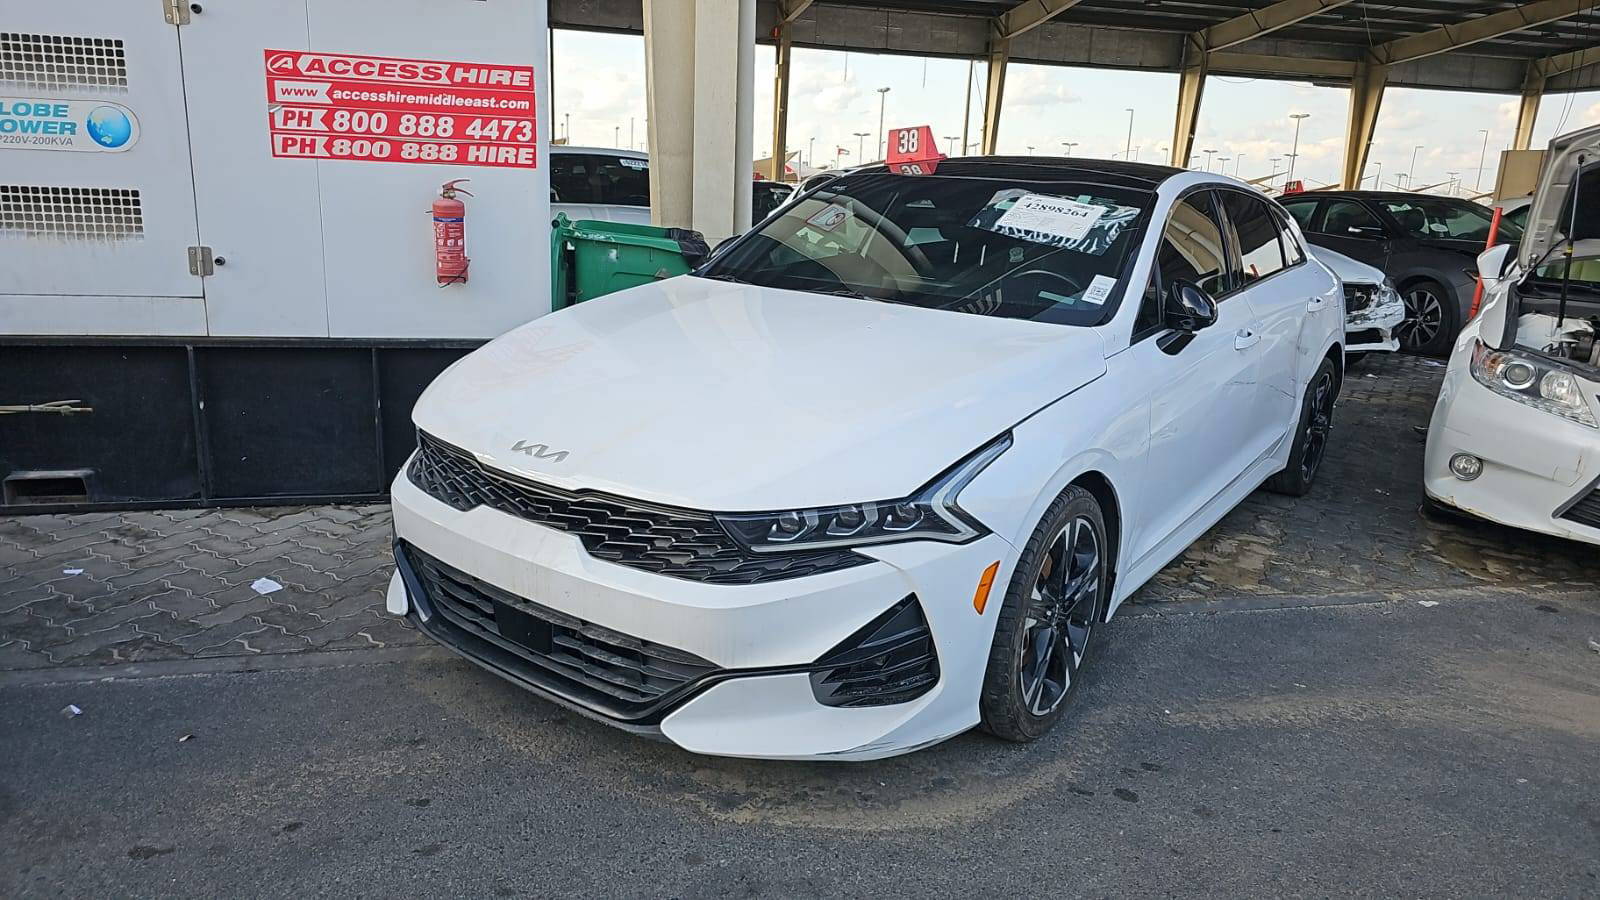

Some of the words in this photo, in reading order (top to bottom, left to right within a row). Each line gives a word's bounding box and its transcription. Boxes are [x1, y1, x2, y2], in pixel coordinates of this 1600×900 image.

[304, 58, 444, 81] ACCESS
[453, 67, 531, 86] HIRE
[280, 87, 318, 97] www
[333, 88, 530, 110] accesshiremiddleeast.com
[282, 109, 313, 127] PH
[332, 110, 388, 133] 800
[398, 114, 454, 138] 888
[465, 119, 532, 142] 4473
[281, 137, 317, 154] PH
[331, 138, 391, 158] 800
[400, 142, 458, 161] 888
[467, 145, 534, 165] HIRE
[898, 129, 918, 153] 38
[1023, 203, 1088, 218] 42898264
